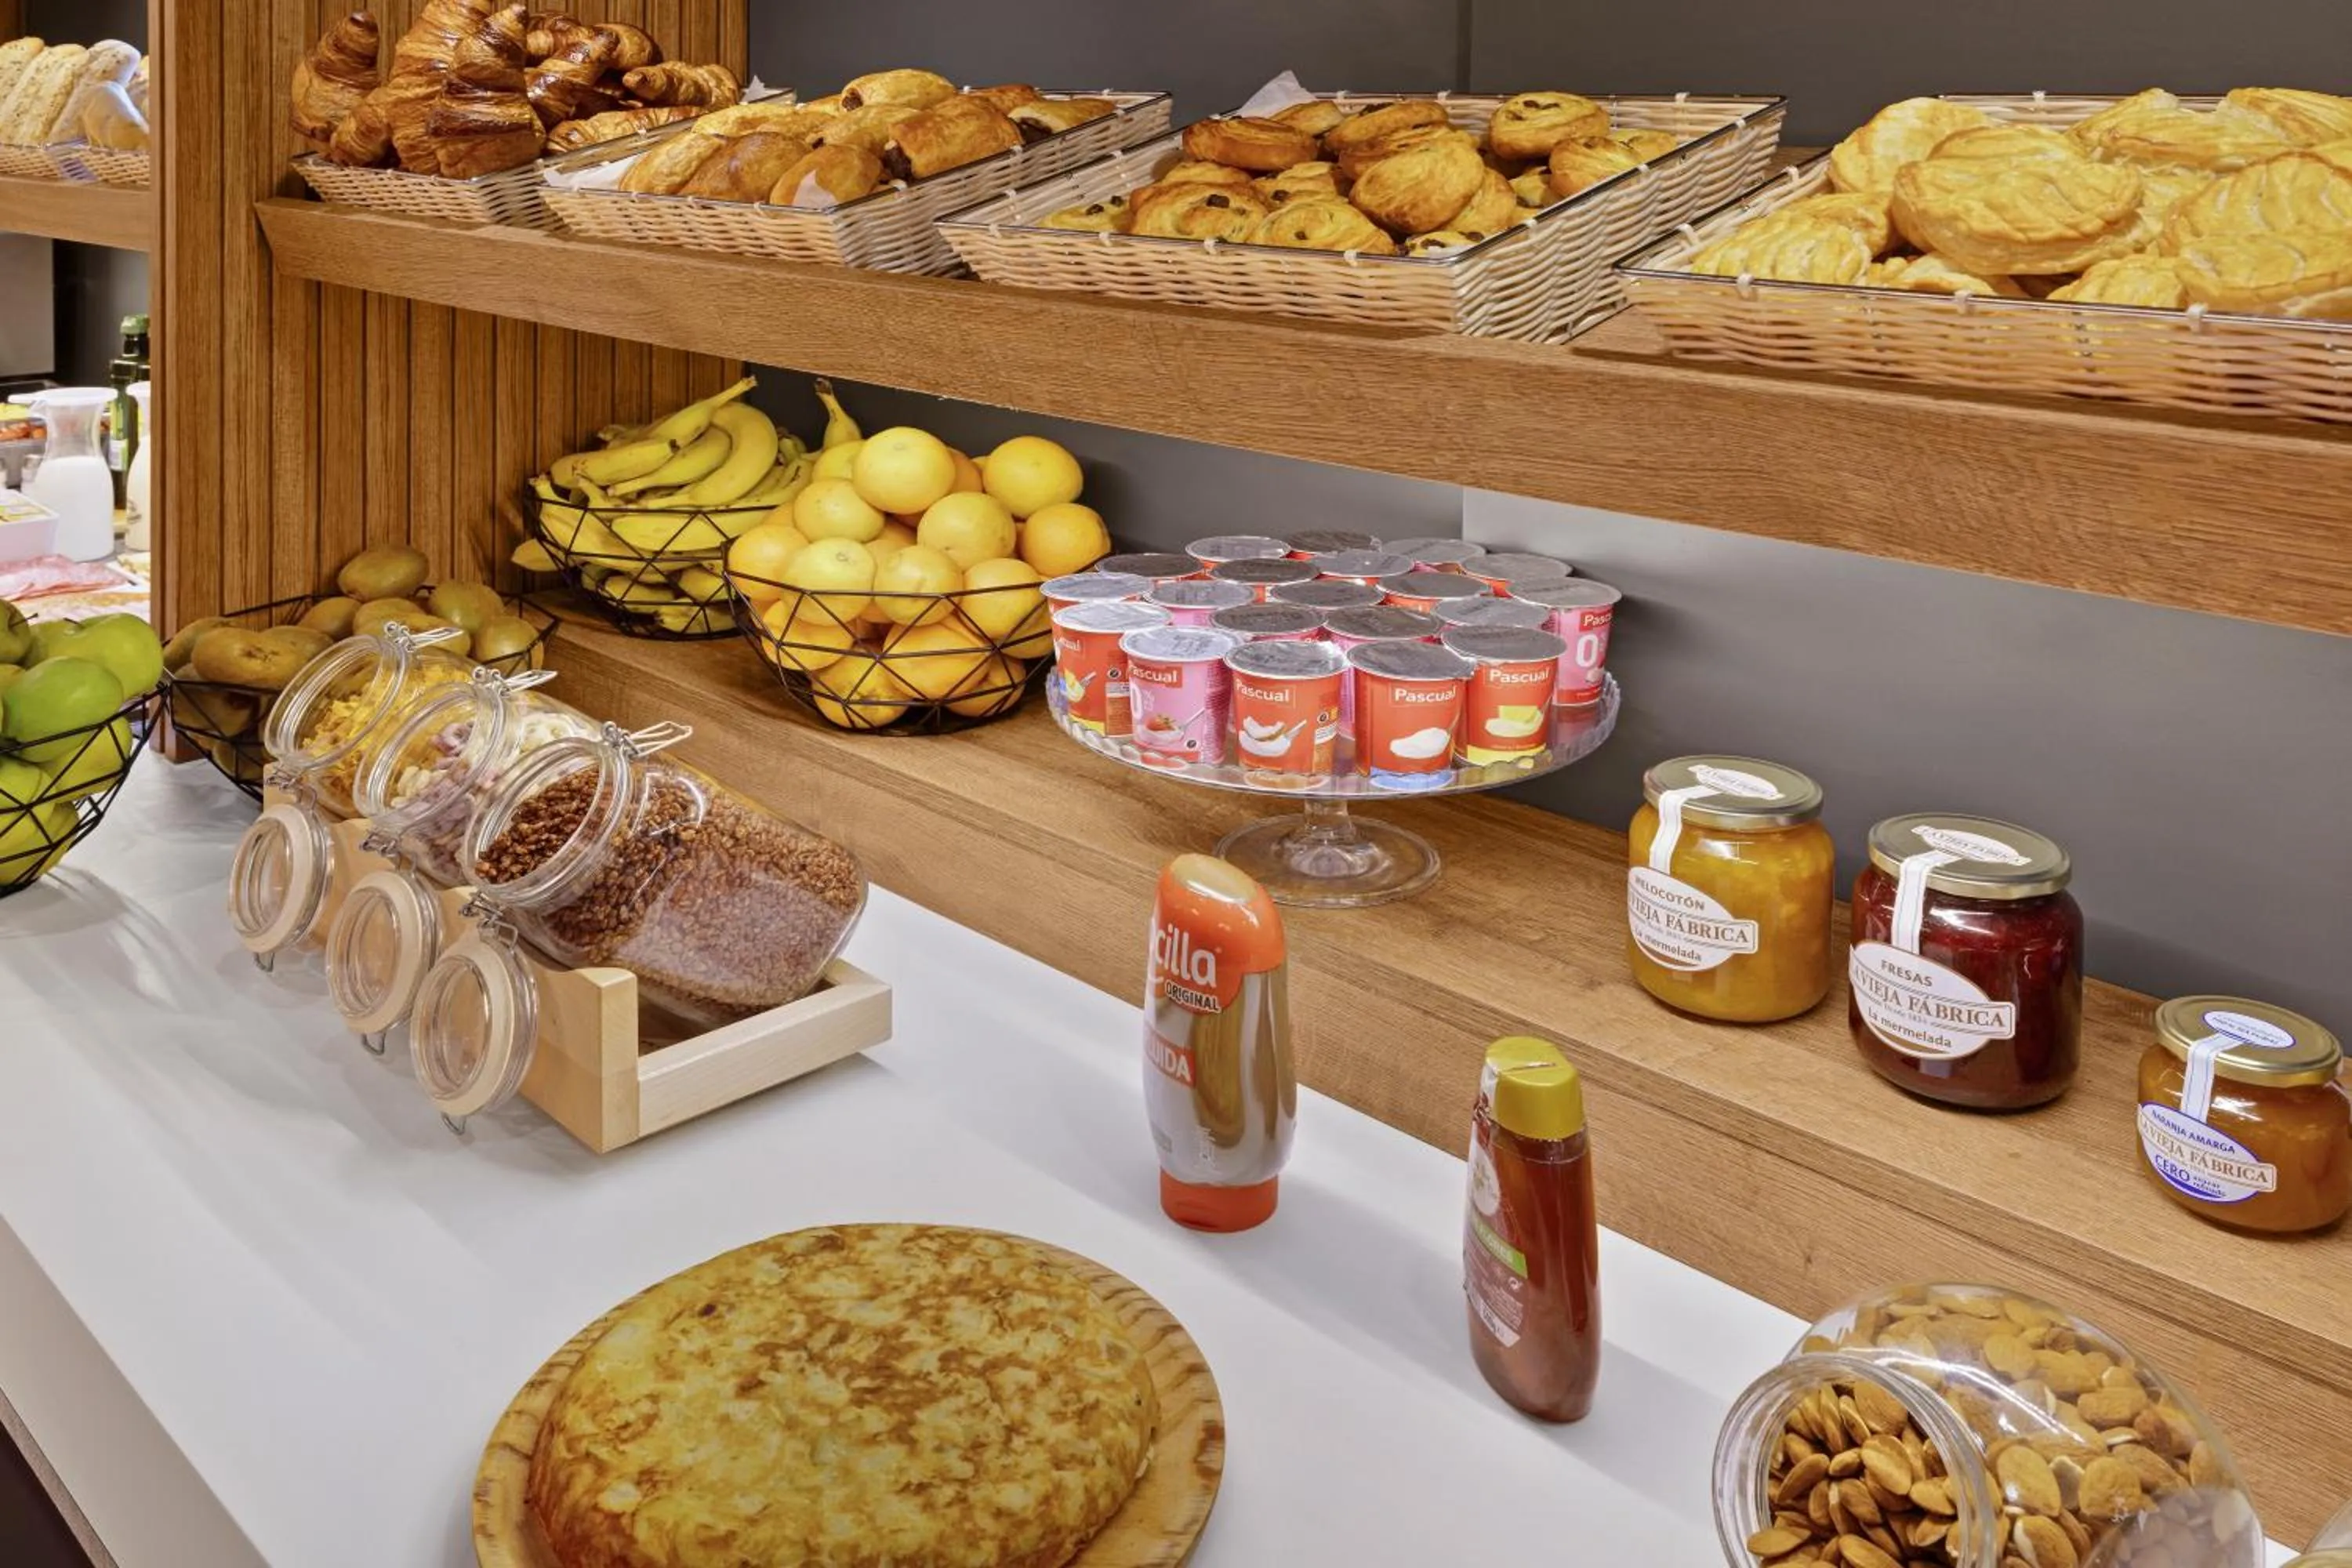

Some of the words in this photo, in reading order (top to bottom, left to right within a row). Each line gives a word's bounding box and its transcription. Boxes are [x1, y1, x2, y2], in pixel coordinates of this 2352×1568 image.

[1490, 667, 1550, 684] Pascual
[1236, 678, 1290, 702] Pascual
[1395, 685, 1457, 702] Pascual
[1666, 912, 1748, 943] FÁBRICA
[1156, 923, 1217, 988] cilla
[1882, 960, 1933, 987] FRESAS
[1166, 980, 1220, 1011] ORIGINAL
[1908, 993, 2006, 1027] FÁBRICA
[1882, 1018, 1952, 1047] mermelada
[2188, 1132, 2235, 1154] AMARGA
[2155, 1154, 2190, 1182] CERO
[2190, 1151, 2268, 1183] FÁBRICA
